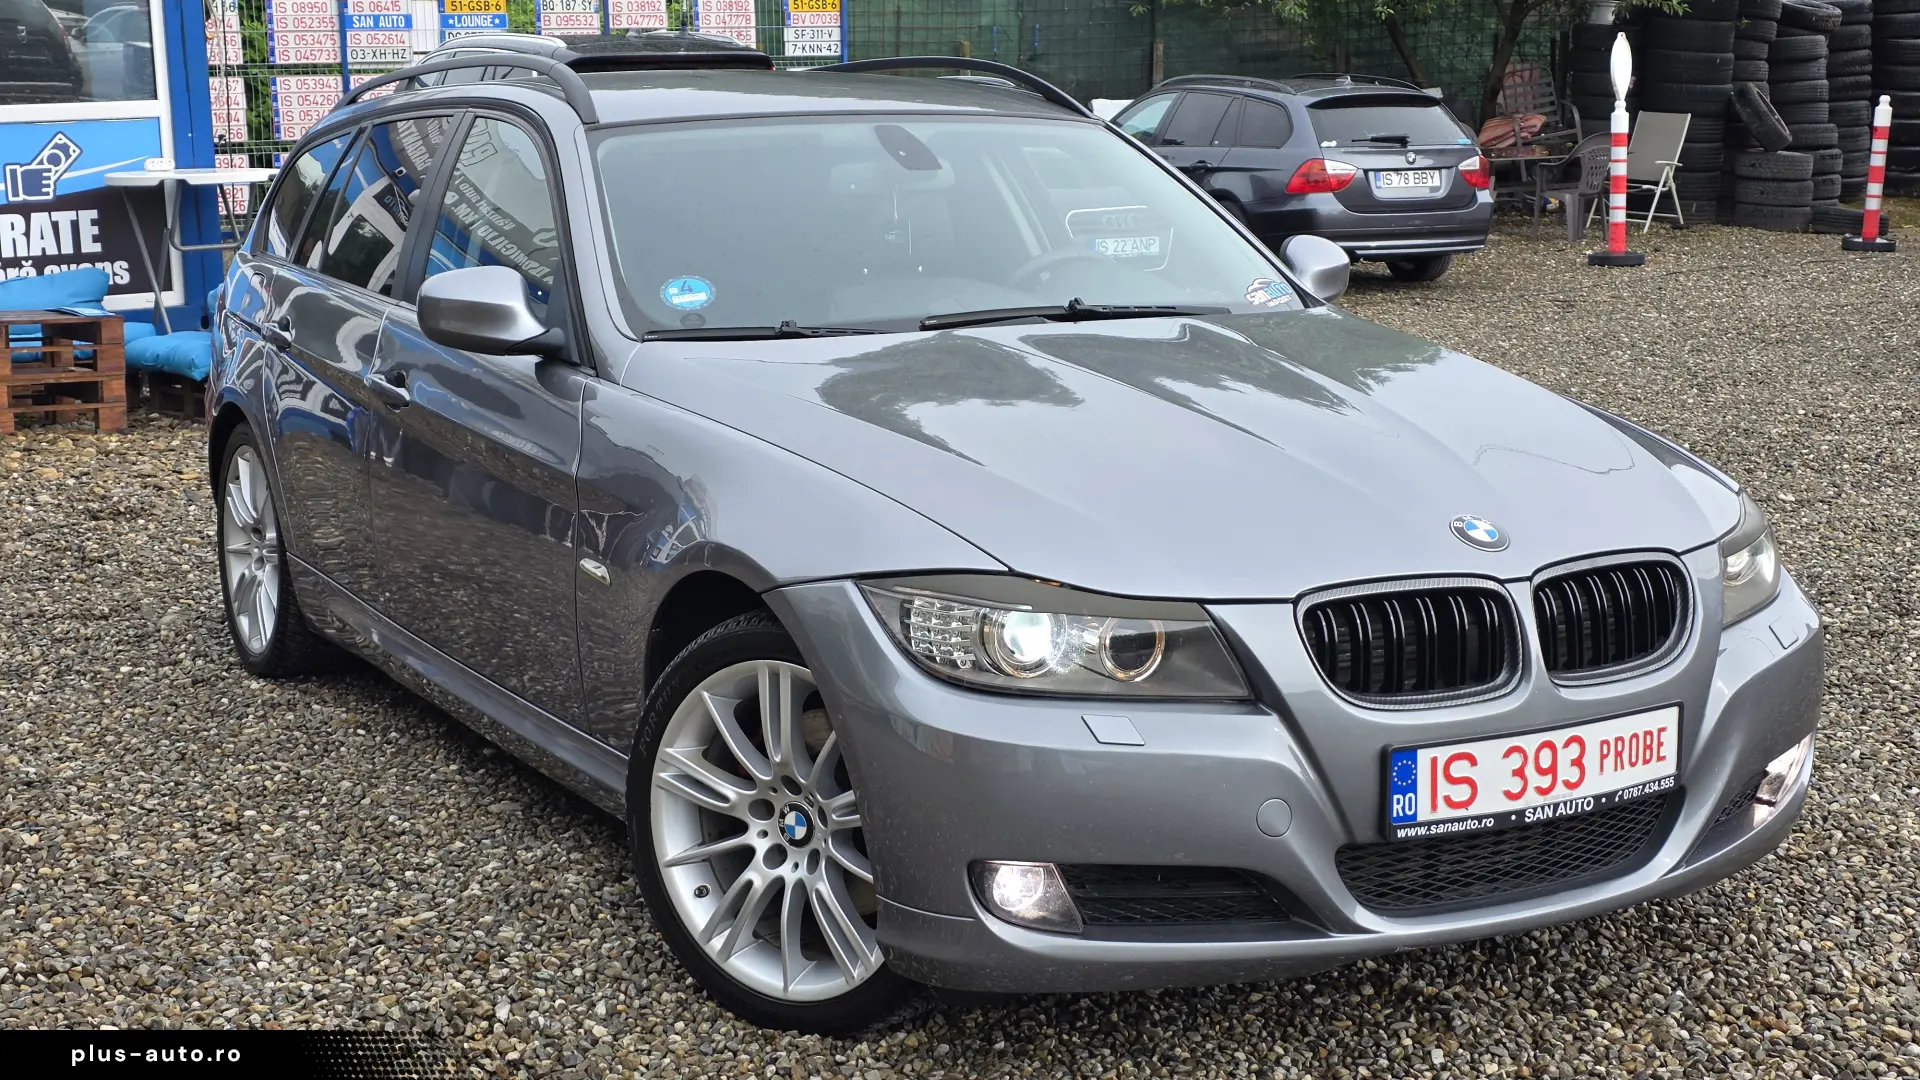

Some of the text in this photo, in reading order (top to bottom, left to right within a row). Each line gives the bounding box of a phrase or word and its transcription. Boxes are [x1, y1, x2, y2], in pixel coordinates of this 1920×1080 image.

[275, 2, 327, 13] IS 08950
[353, 0, 401, 12] IS 06415
[612, 1, 662, 12] IS 038192
[702, 0, 750, 11] IS 038192
[276, 16, 335, 29] IS 052355
[352, 15, 405, 28] SAN AUTO
[454, 15, 494, 27] LOUNGE
[543, 15, 594, 26] B 095532
[612, 14, 664, 26] IS 047778
[701, 14, 711, 25] IS
[792, 14, 806, 24] BV
[277, 34, 337, 46] IS 053475
[350, 33, 405, 45] IS 052614
[278, 49, 338, 61] IS 045733
[279, 78, 339, 91] IS 053943
[280, 95, 292, 107] IS
[282, 110, 294, 122] IS
[284, 127, 296, 138] IS
[1382, 171, 1436, 186] IS 78 BBY
[1097, 240, 1109, 254] IS
[1113, 239, 1128, 253] 22
[1429, 725, 1668, 814] IS 393 PROBE
[1392, 792, 1416, 818] RO
[1396, 776, 1675, 839] www.sanauto.ro SAN AUTO 0787.434.555
